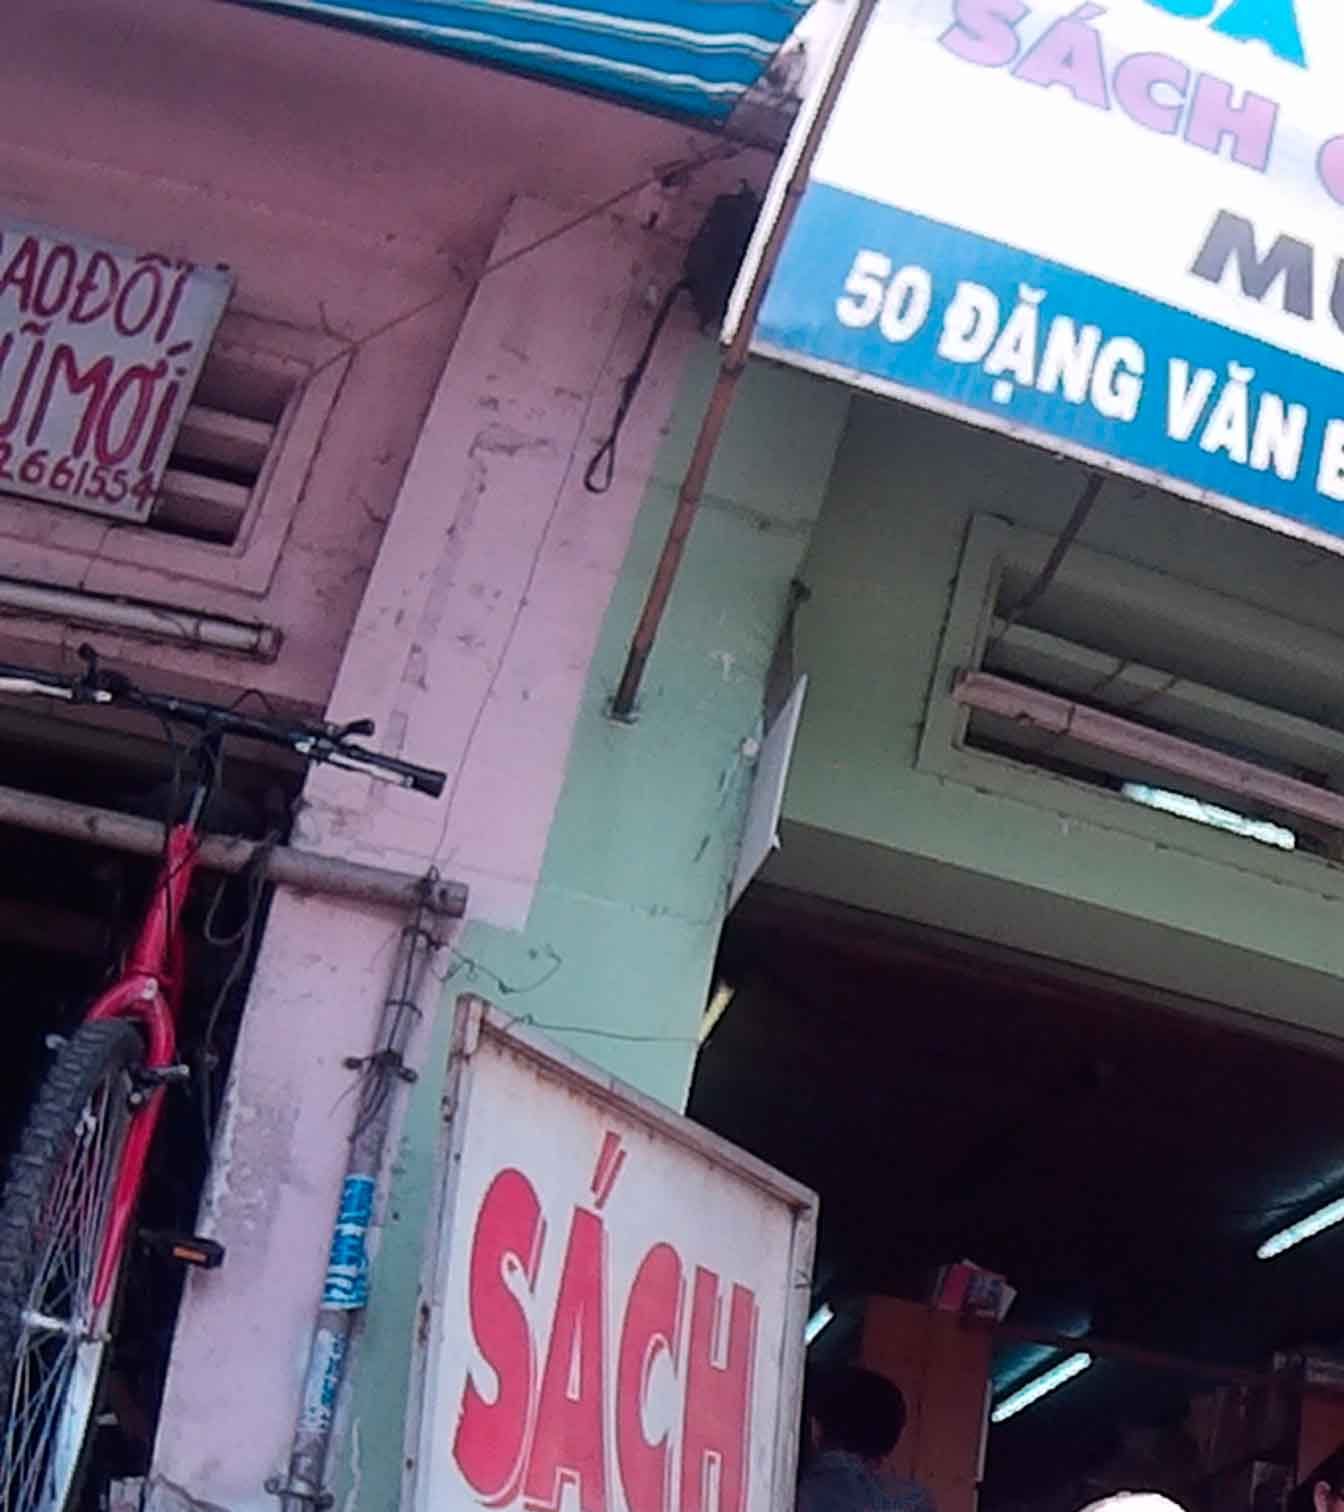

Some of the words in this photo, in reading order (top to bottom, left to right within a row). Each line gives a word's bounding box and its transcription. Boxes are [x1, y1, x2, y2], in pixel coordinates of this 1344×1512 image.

[936, 0, 1279, 174] SÁCH
[836, 247, 933, 342] 50
[938, 281, 1145, 422] ĐẶNG
[1166, 359, 1307, 481] VĂN
